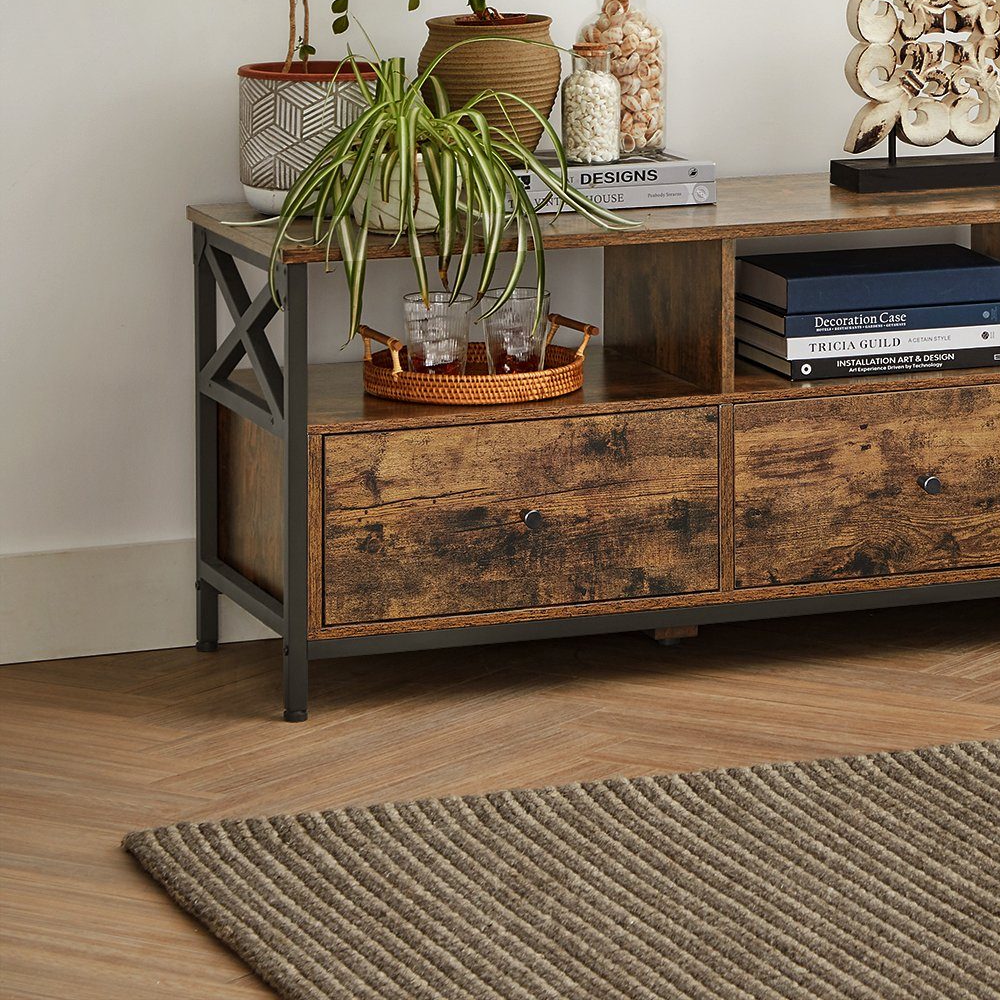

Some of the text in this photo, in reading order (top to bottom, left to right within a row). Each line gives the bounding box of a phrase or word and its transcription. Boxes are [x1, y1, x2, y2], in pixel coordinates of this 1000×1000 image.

[580, 169, 658, 185] DESIGNS
[814, 312, 907, 328] Decoration Case
[808, 337, 901, 353] TRICIA GUILD
[836, 353, 955, 368] INSTALLATION ART & DESIGN
